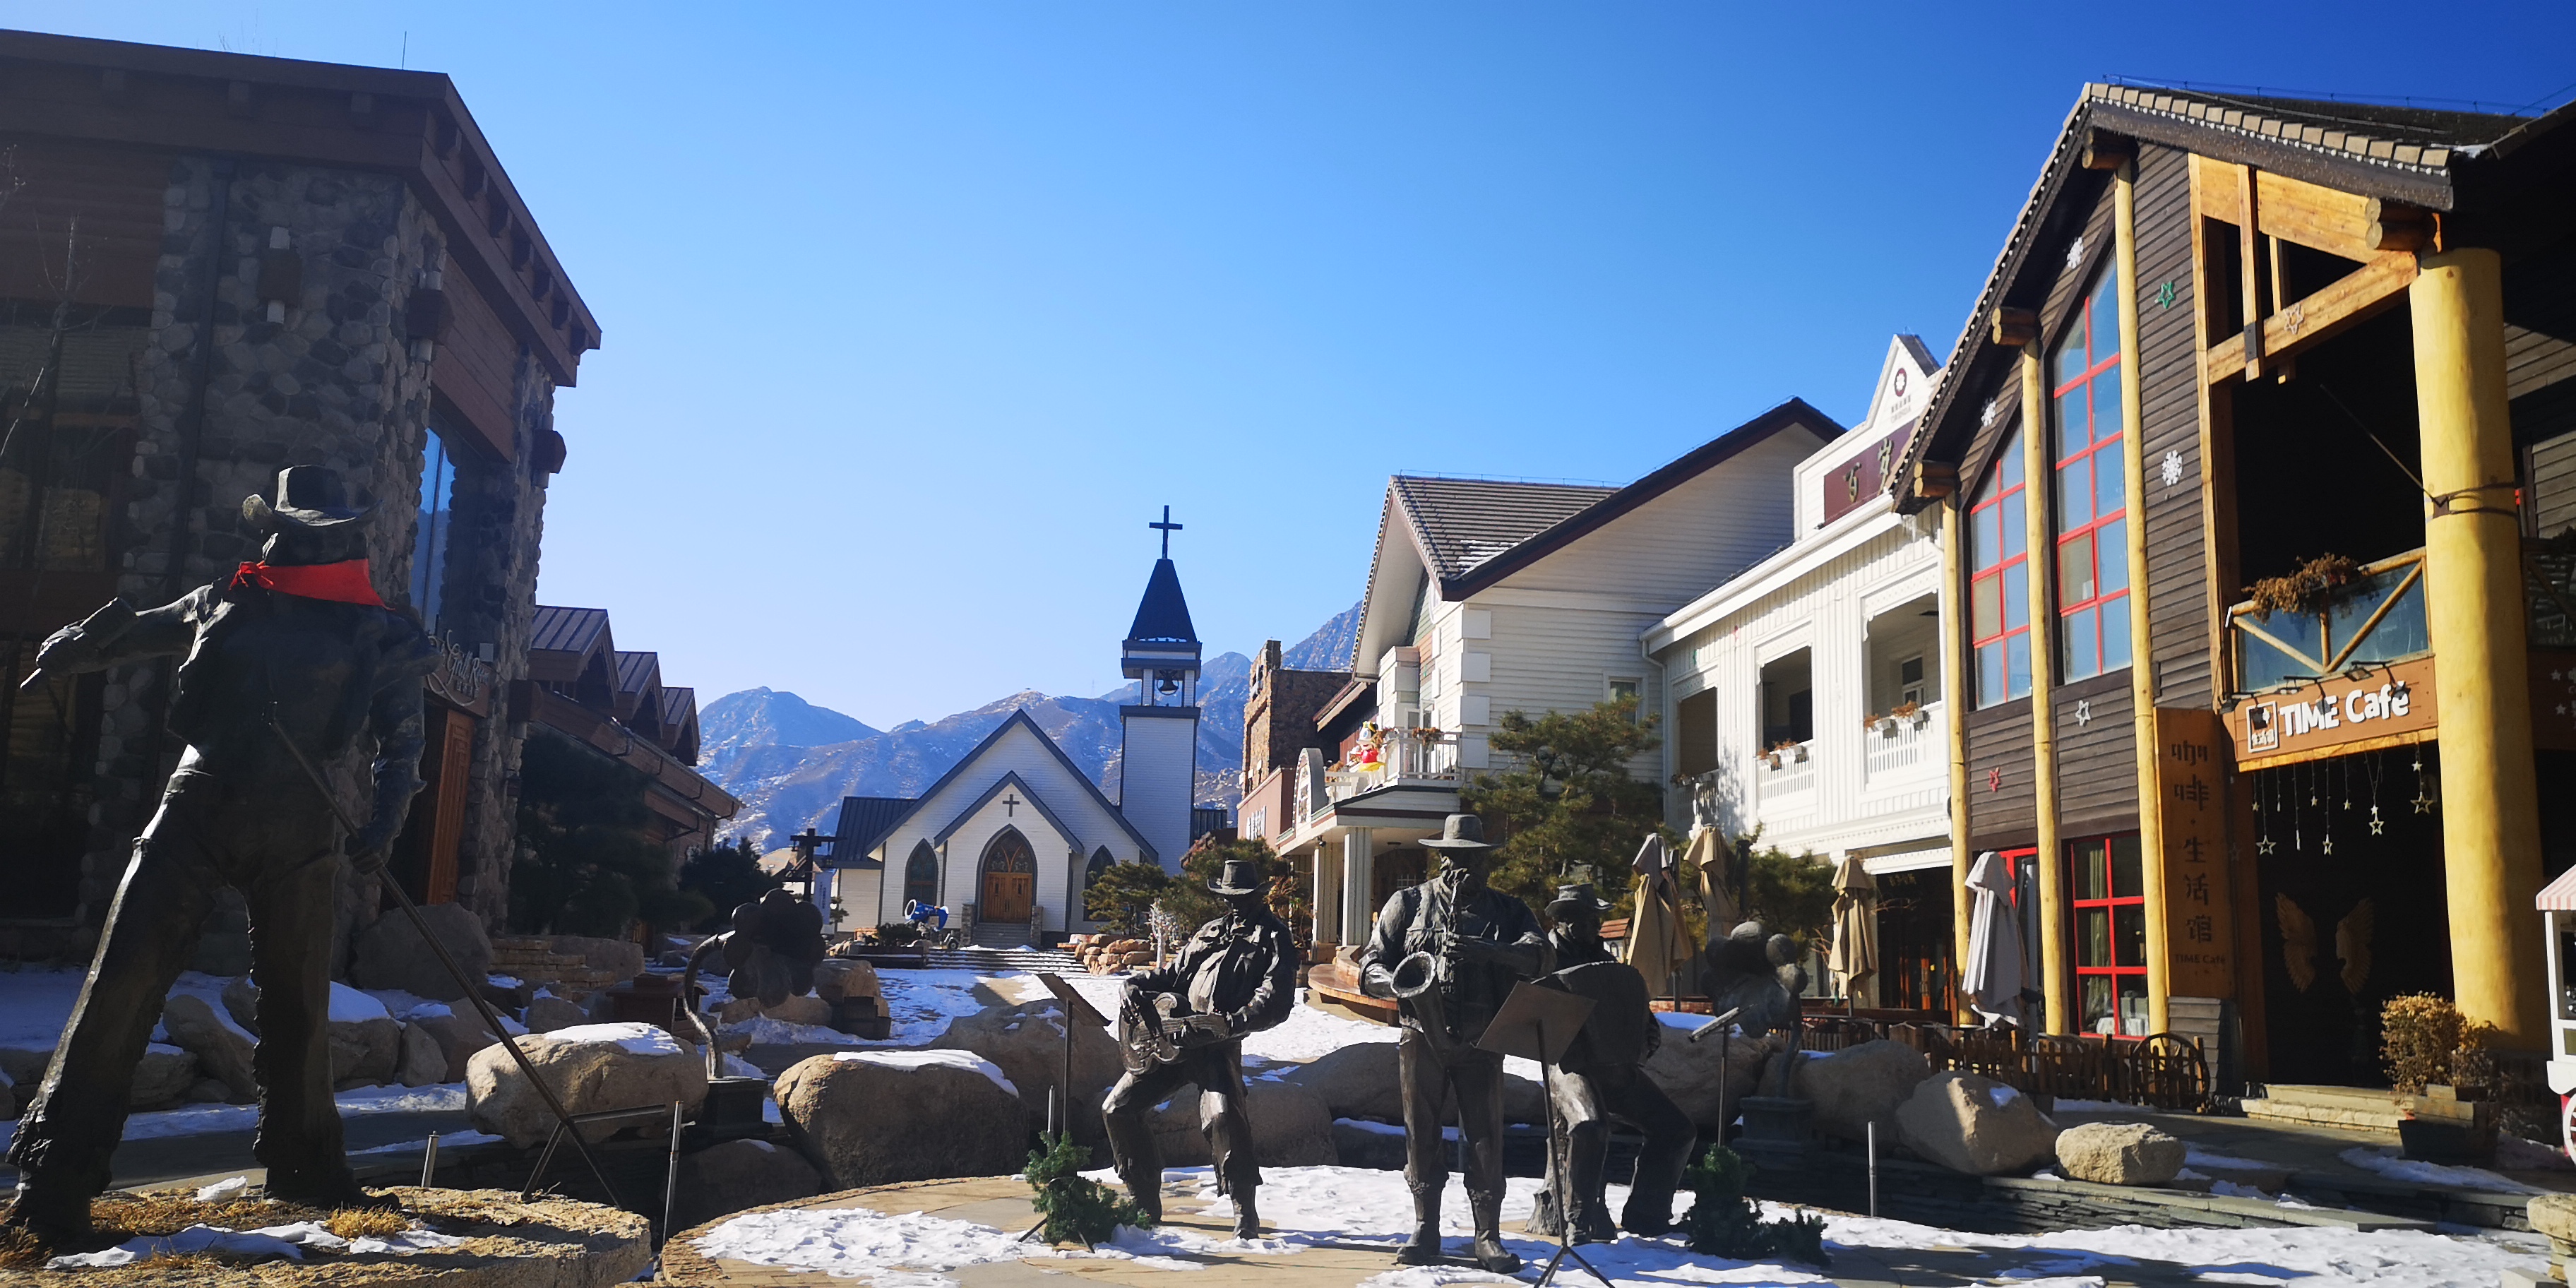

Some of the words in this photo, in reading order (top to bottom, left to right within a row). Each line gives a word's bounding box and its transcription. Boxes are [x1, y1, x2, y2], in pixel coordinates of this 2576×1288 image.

[2279, 696, 2339, 737] TIME
[2346, 681, 2409, 723] Café
[2176, 954, 2200, 963] TIME
